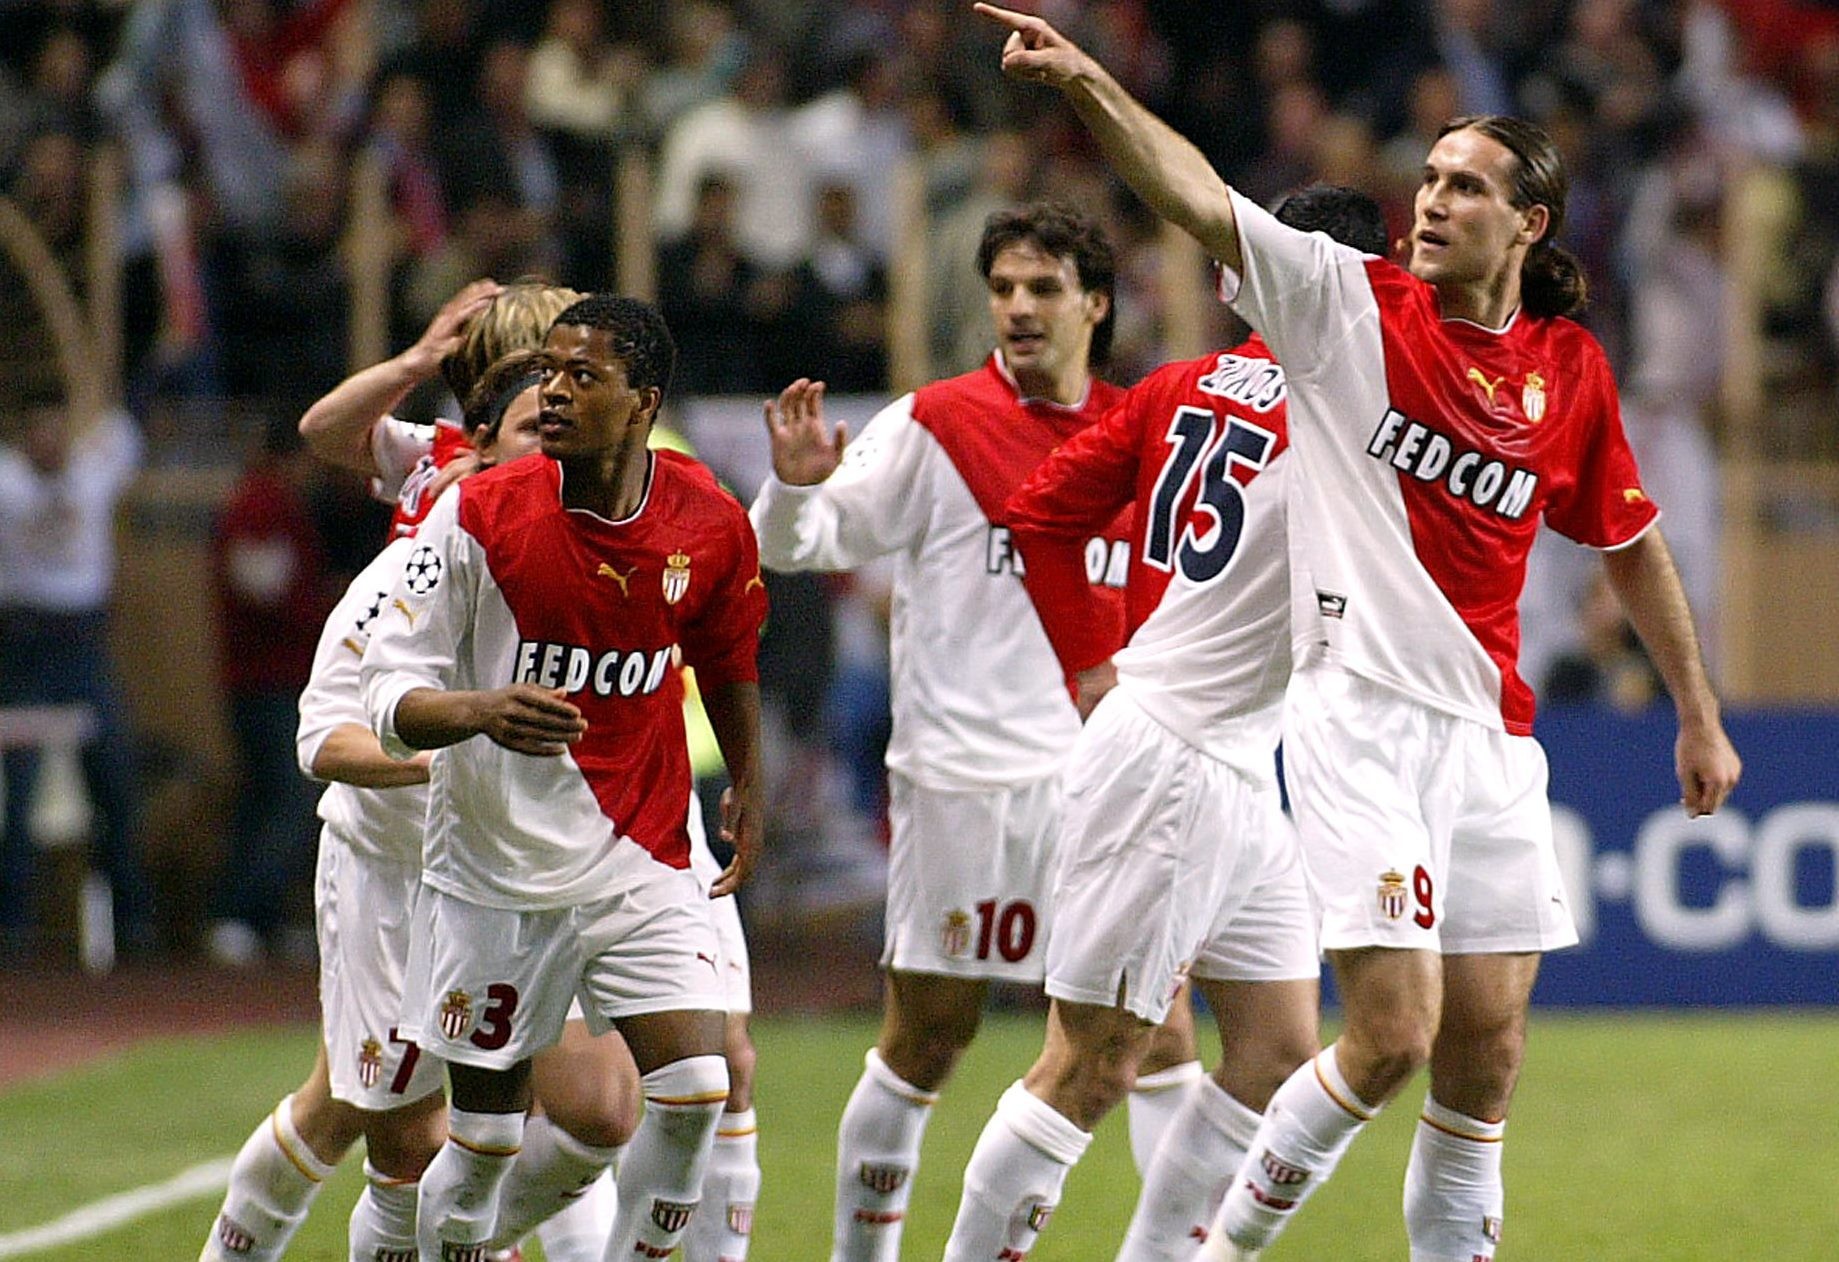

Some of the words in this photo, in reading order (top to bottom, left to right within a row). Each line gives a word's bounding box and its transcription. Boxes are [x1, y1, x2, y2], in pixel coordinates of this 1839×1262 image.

[1367, 406, 1538, 519] FEDCOM
[1143, 405, 1277, 589] 15
[1413, 864, 1435, 930] 9
[976, 900, 1036, 962] 10
[470, 983, 518, 1050] 3
[389, 1027, 421, 1094] 7
